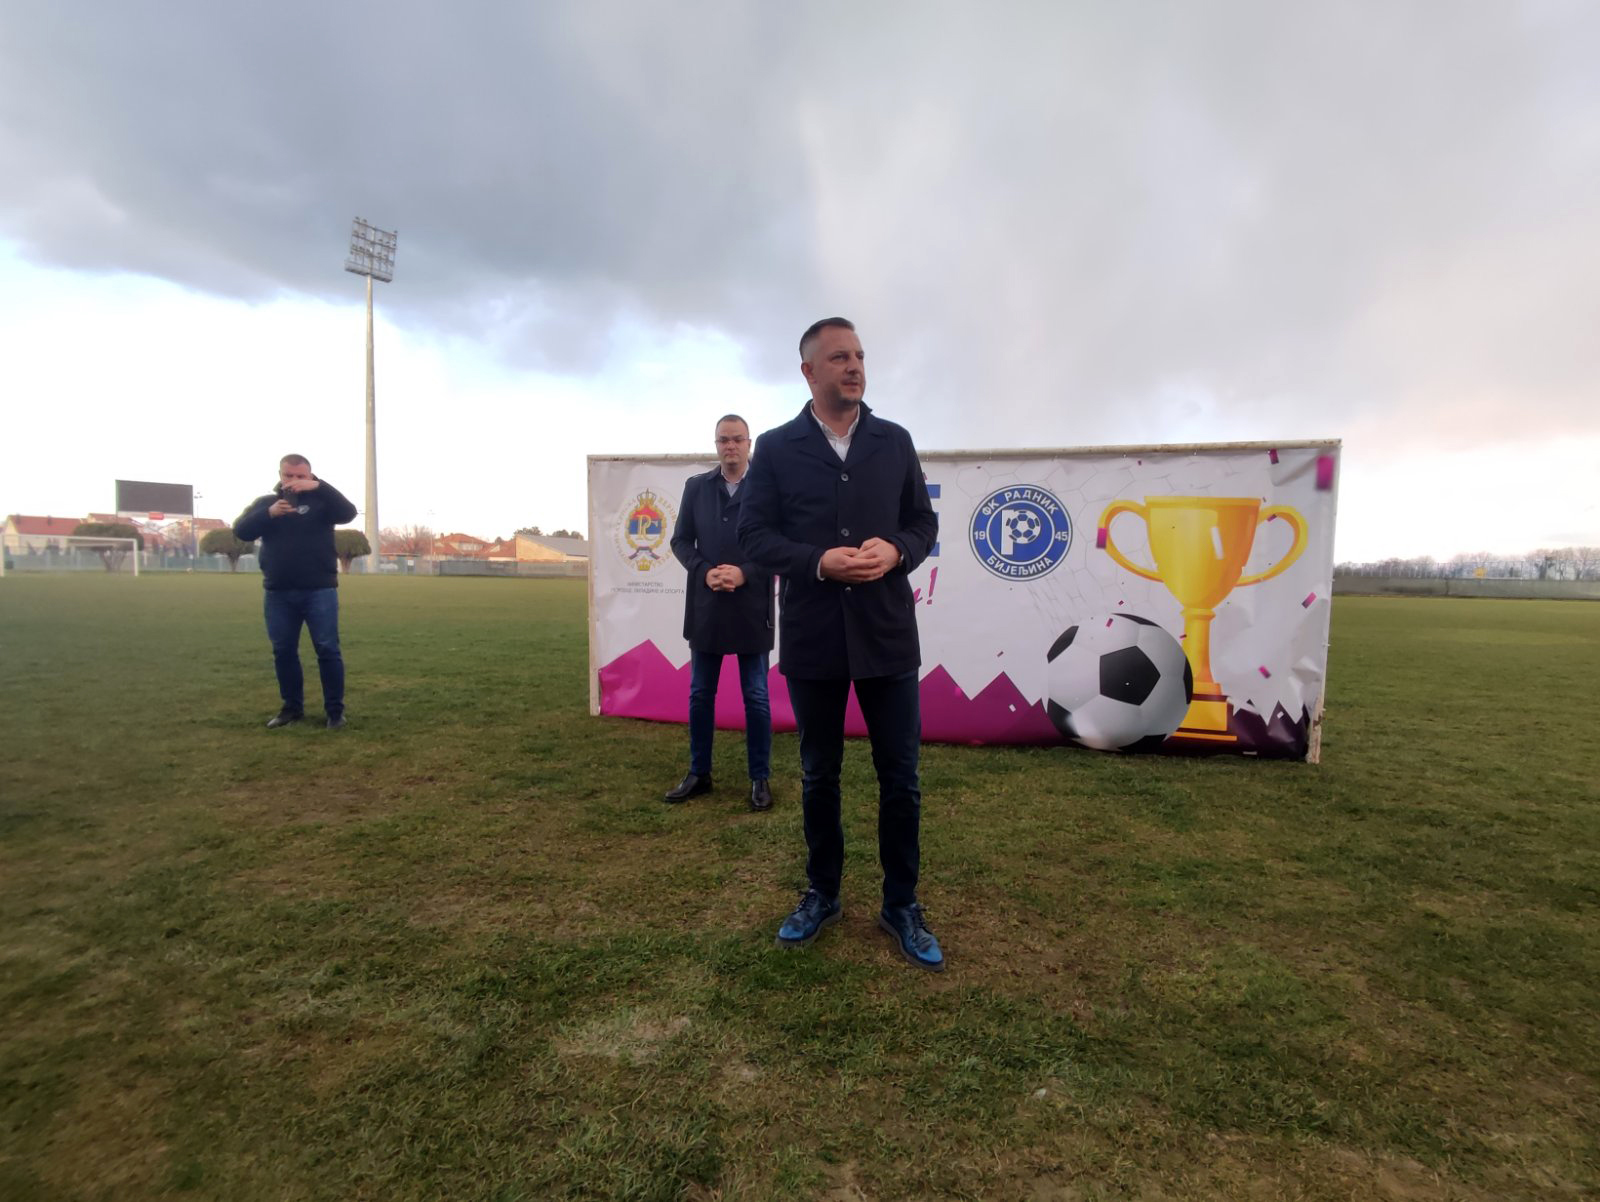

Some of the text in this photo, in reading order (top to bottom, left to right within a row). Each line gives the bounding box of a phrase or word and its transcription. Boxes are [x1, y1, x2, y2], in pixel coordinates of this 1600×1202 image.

[982, 490, 1059, 515] ФК РАДНИК
[974, 531, 986, 540] 19
[1055, 531, 1068, 541] 45
[987, 555, 1053, 576] БИЈЕЉИНА
